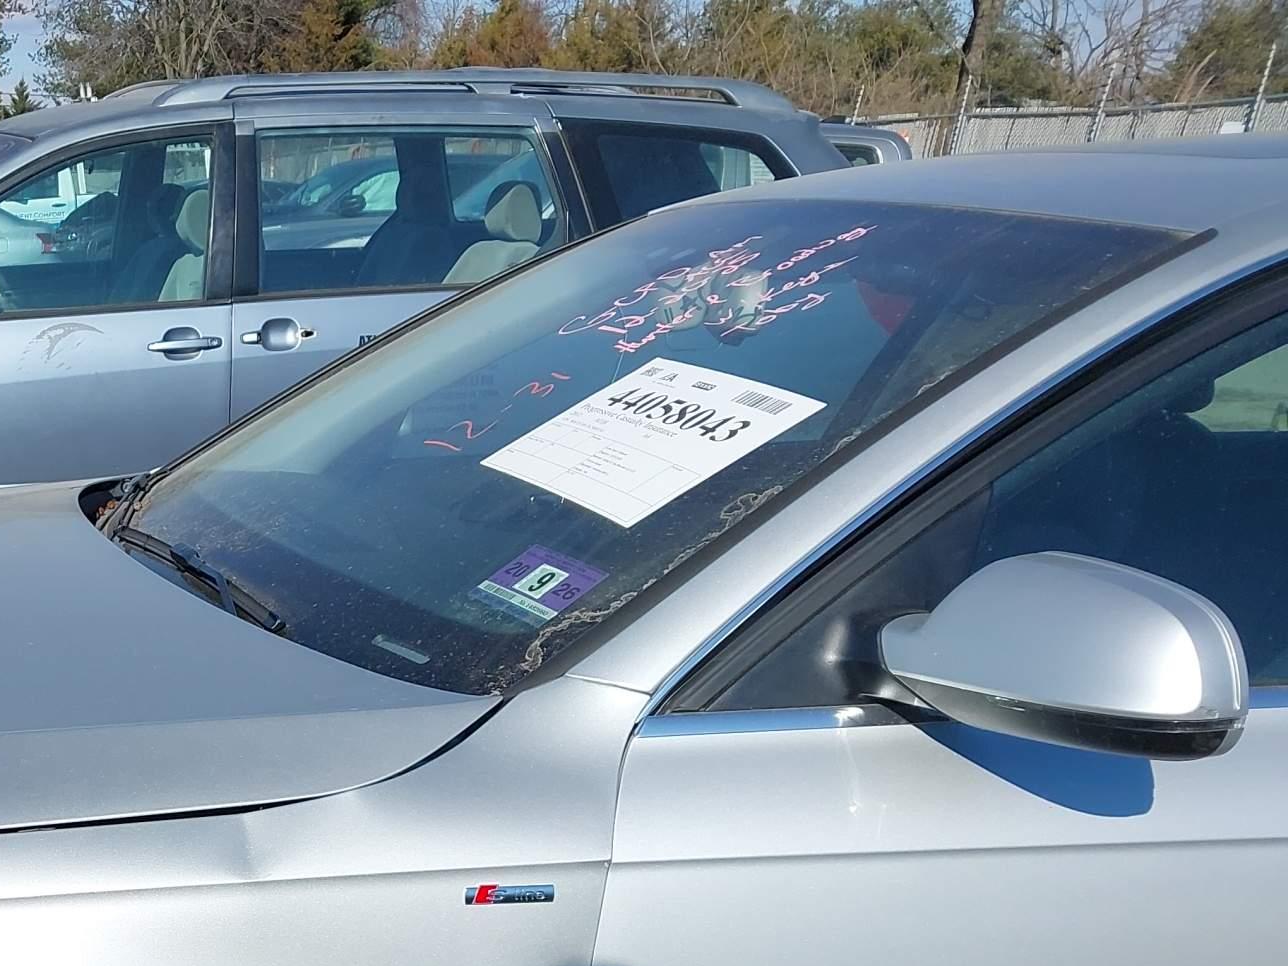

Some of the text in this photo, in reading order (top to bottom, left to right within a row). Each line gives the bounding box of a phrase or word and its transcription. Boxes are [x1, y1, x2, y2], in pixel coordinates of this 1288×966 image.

[423, 371, 572, 452] 12-31
[607, 387, 752, 442] 44058043
[504, 561, 531, 578] 20
[527, 572, 557, 592] 9
[551, 582, 581, 601] 26
